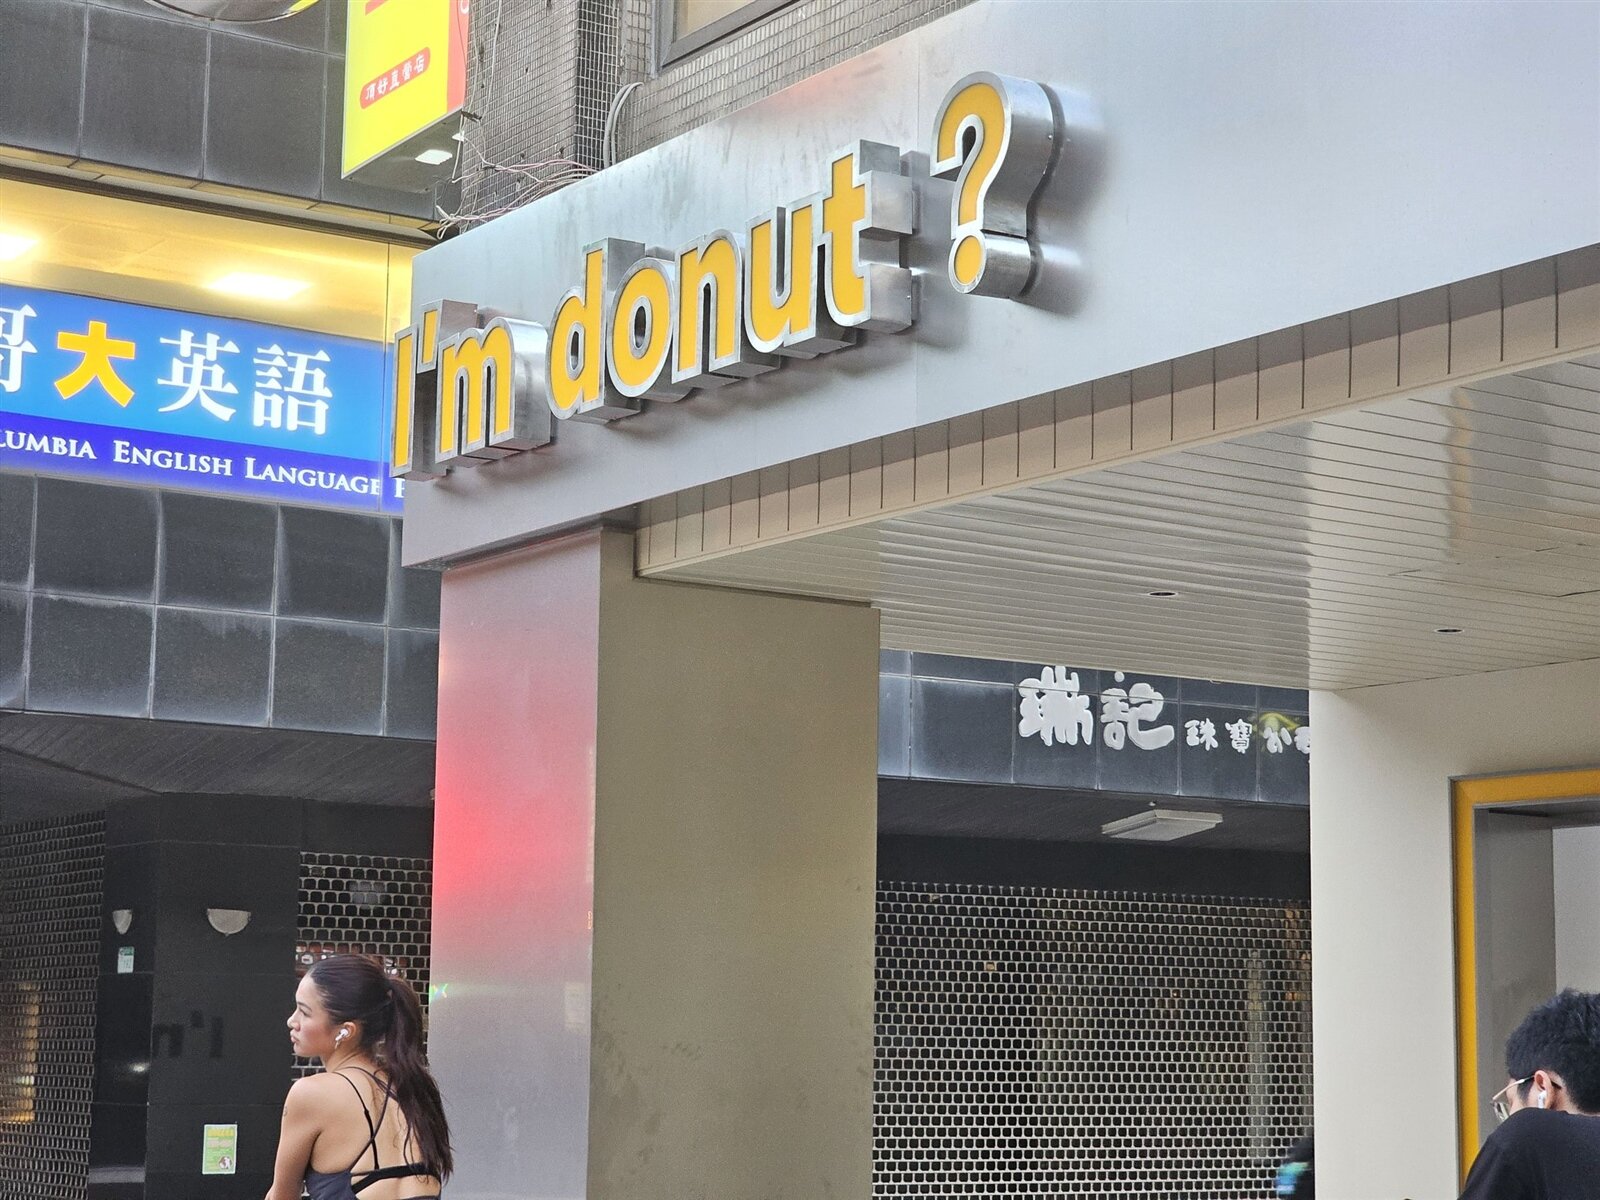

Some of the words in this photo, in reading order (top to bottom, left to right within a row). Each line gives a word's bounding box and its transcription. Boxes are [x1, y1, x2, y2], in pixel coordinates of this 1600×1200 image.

[365, 53, 424, 101] 頂好直營店
[390, 299, 516, 478] I'm
[546, 140, 870, 421] donut
[930, 71, 1012, 294] ?
[113, 439, 233, 477] ENGLISH
[245, 456, 380, 496] LANGUAGE
